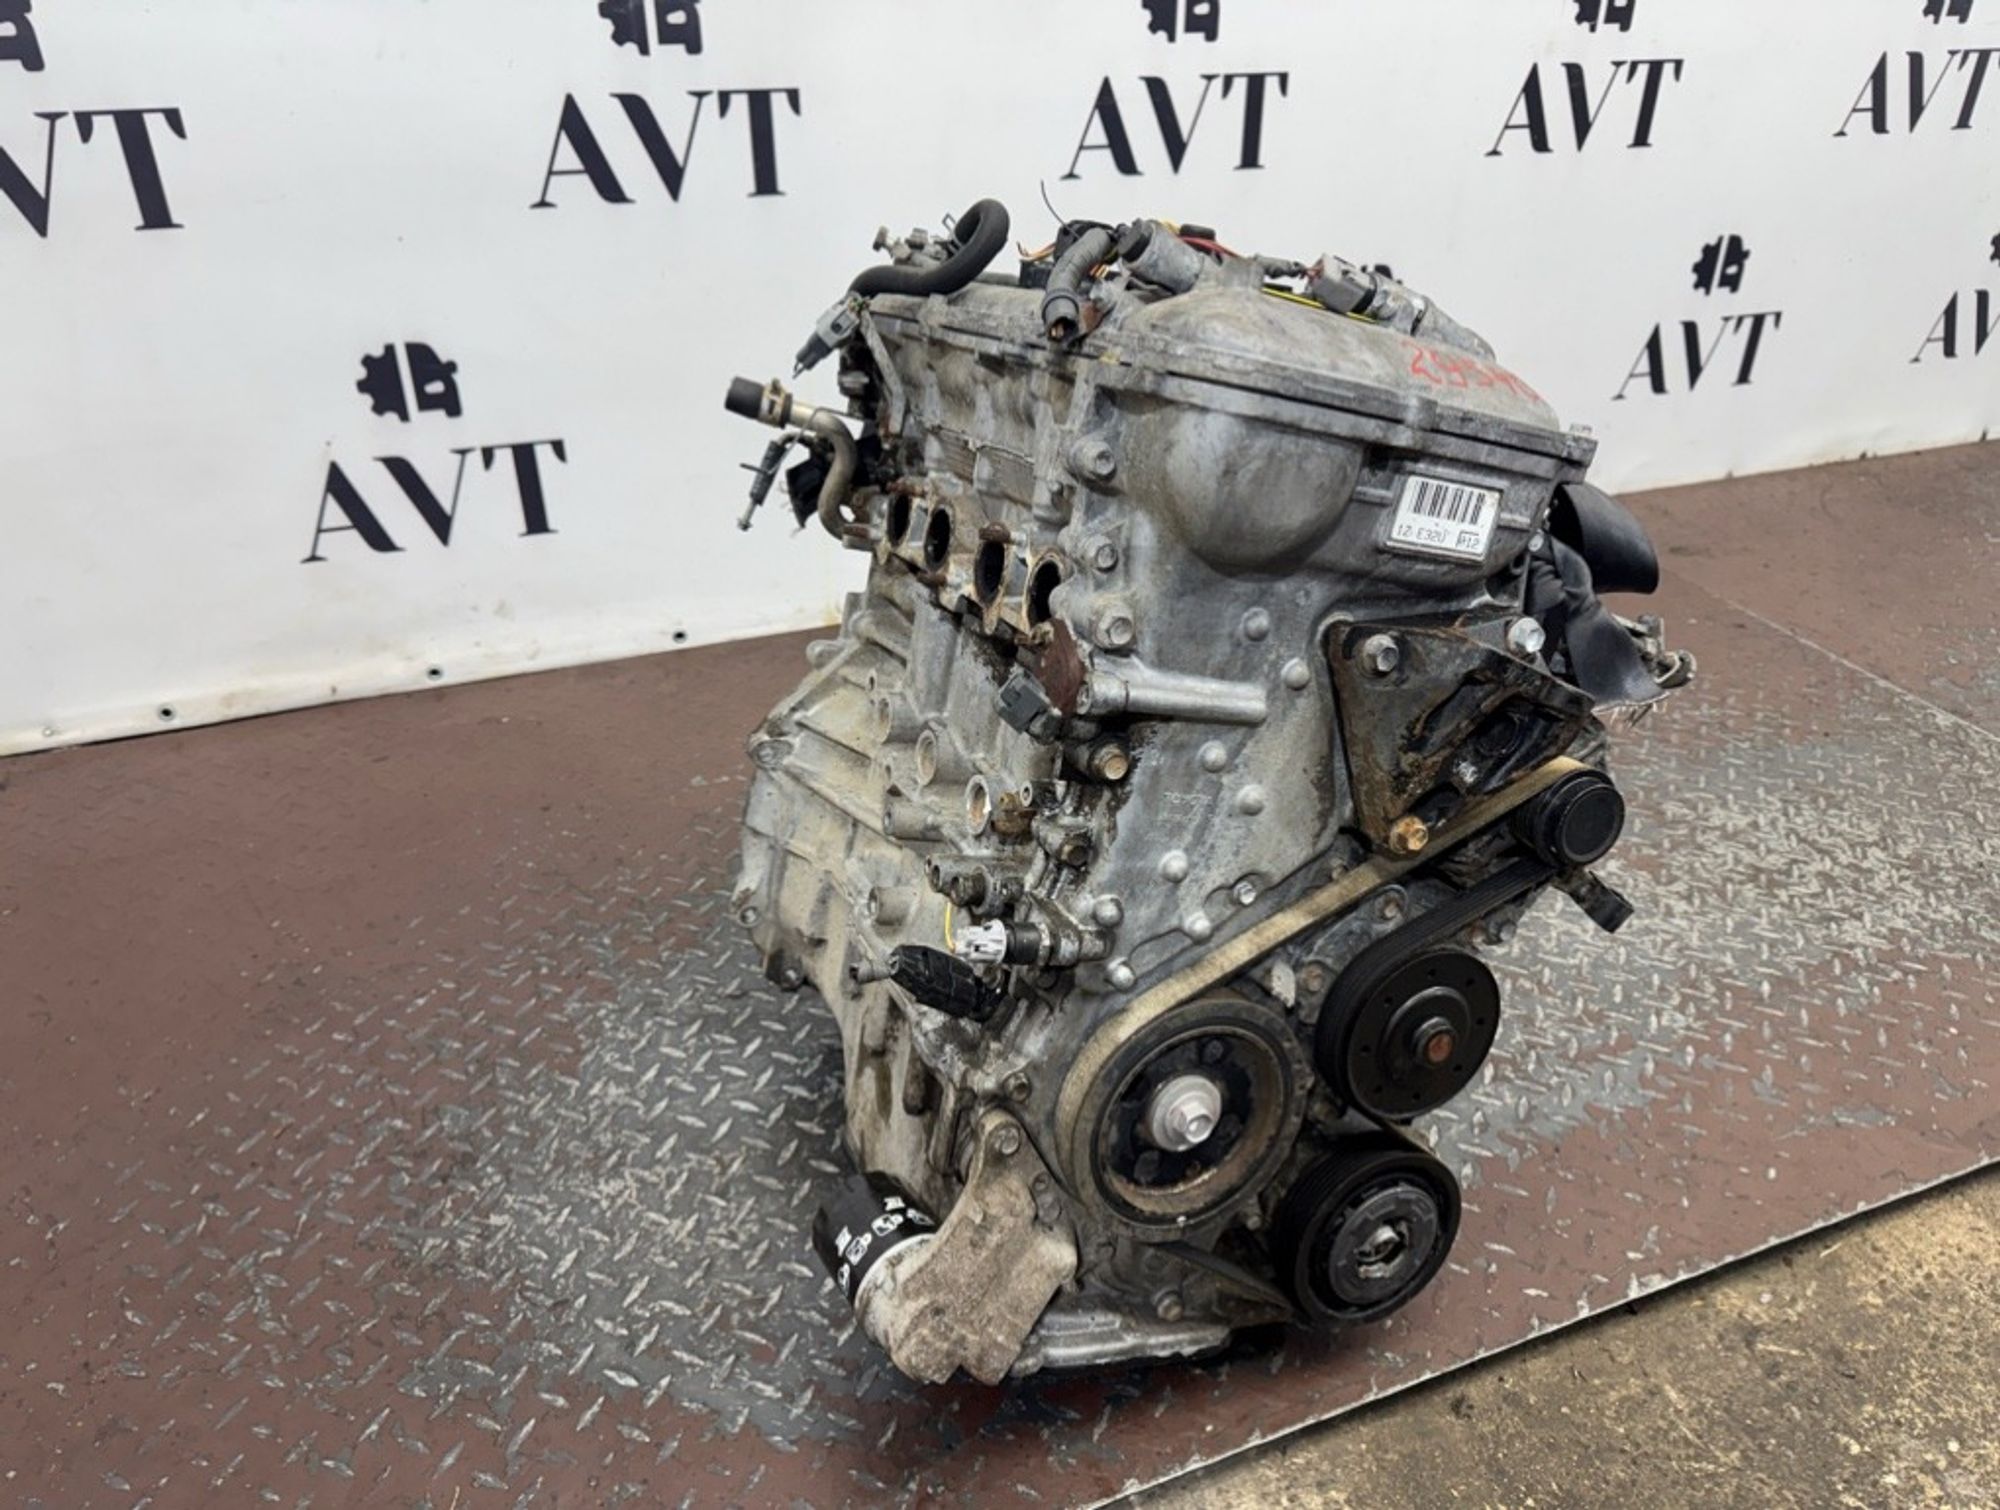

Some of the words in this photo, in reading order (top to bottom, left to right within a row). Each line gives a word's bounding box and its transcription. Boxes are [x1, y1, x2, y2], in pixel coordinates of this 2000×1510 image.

[1060, 71, 1290, 180] AVT
[1485, 58, 1684, 157] AVT
[1832, 48, 2000, 137] AVT
[0, 107, 187, 239] VT
[530, 87, 802, 209] AVT
[1611, 311, 1783, 401] AVT
[1908, 288, 2000, 363] AV
[300, 438, 568, 564] AVT
